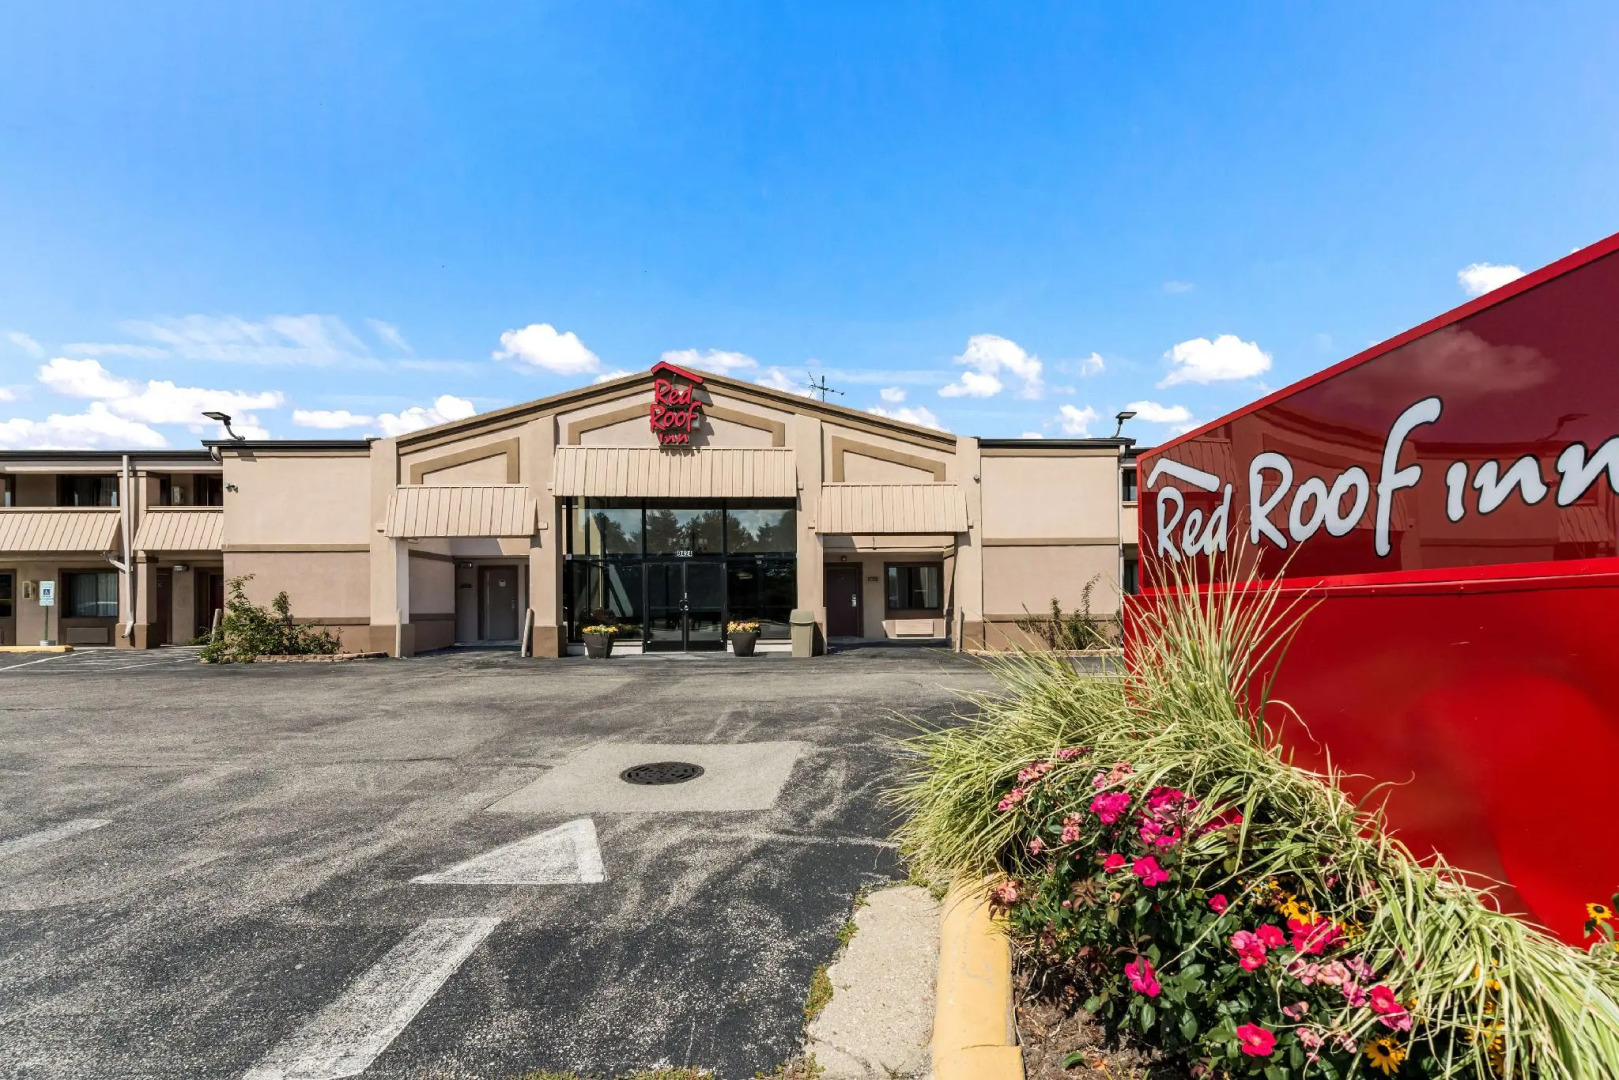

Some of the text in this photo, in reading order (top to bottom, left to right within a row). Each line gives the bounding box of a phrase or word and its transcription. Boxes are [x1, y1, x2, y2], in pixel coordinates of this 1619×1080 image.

[654, 379, 693, 405] Red
[649, 401, 702, 433] Roof
[1156, 483, 1232, 562] Red
[1249, 395, 1443, 558] Roof
